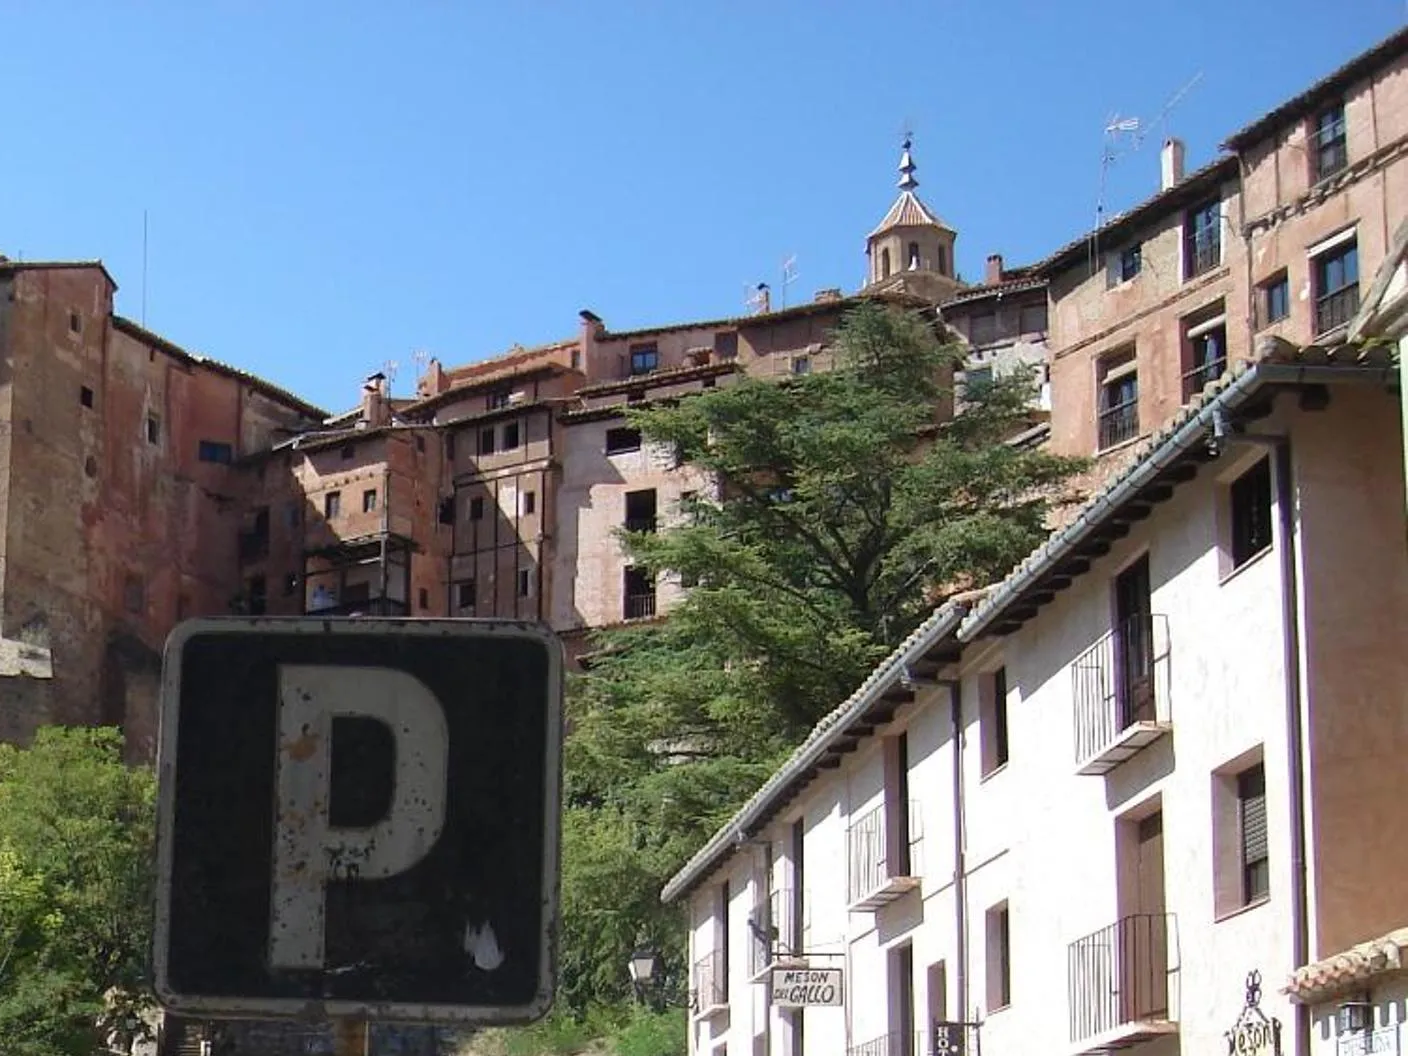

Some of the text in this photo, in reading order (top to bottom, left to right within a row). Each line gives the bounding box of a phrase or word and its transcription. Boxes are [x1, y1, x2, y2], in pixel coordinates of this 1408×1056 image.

[269, 664, 450, 971] P
[784, 972, 828, 983] MESON
[790, 985, 834, 1003] GALLO
